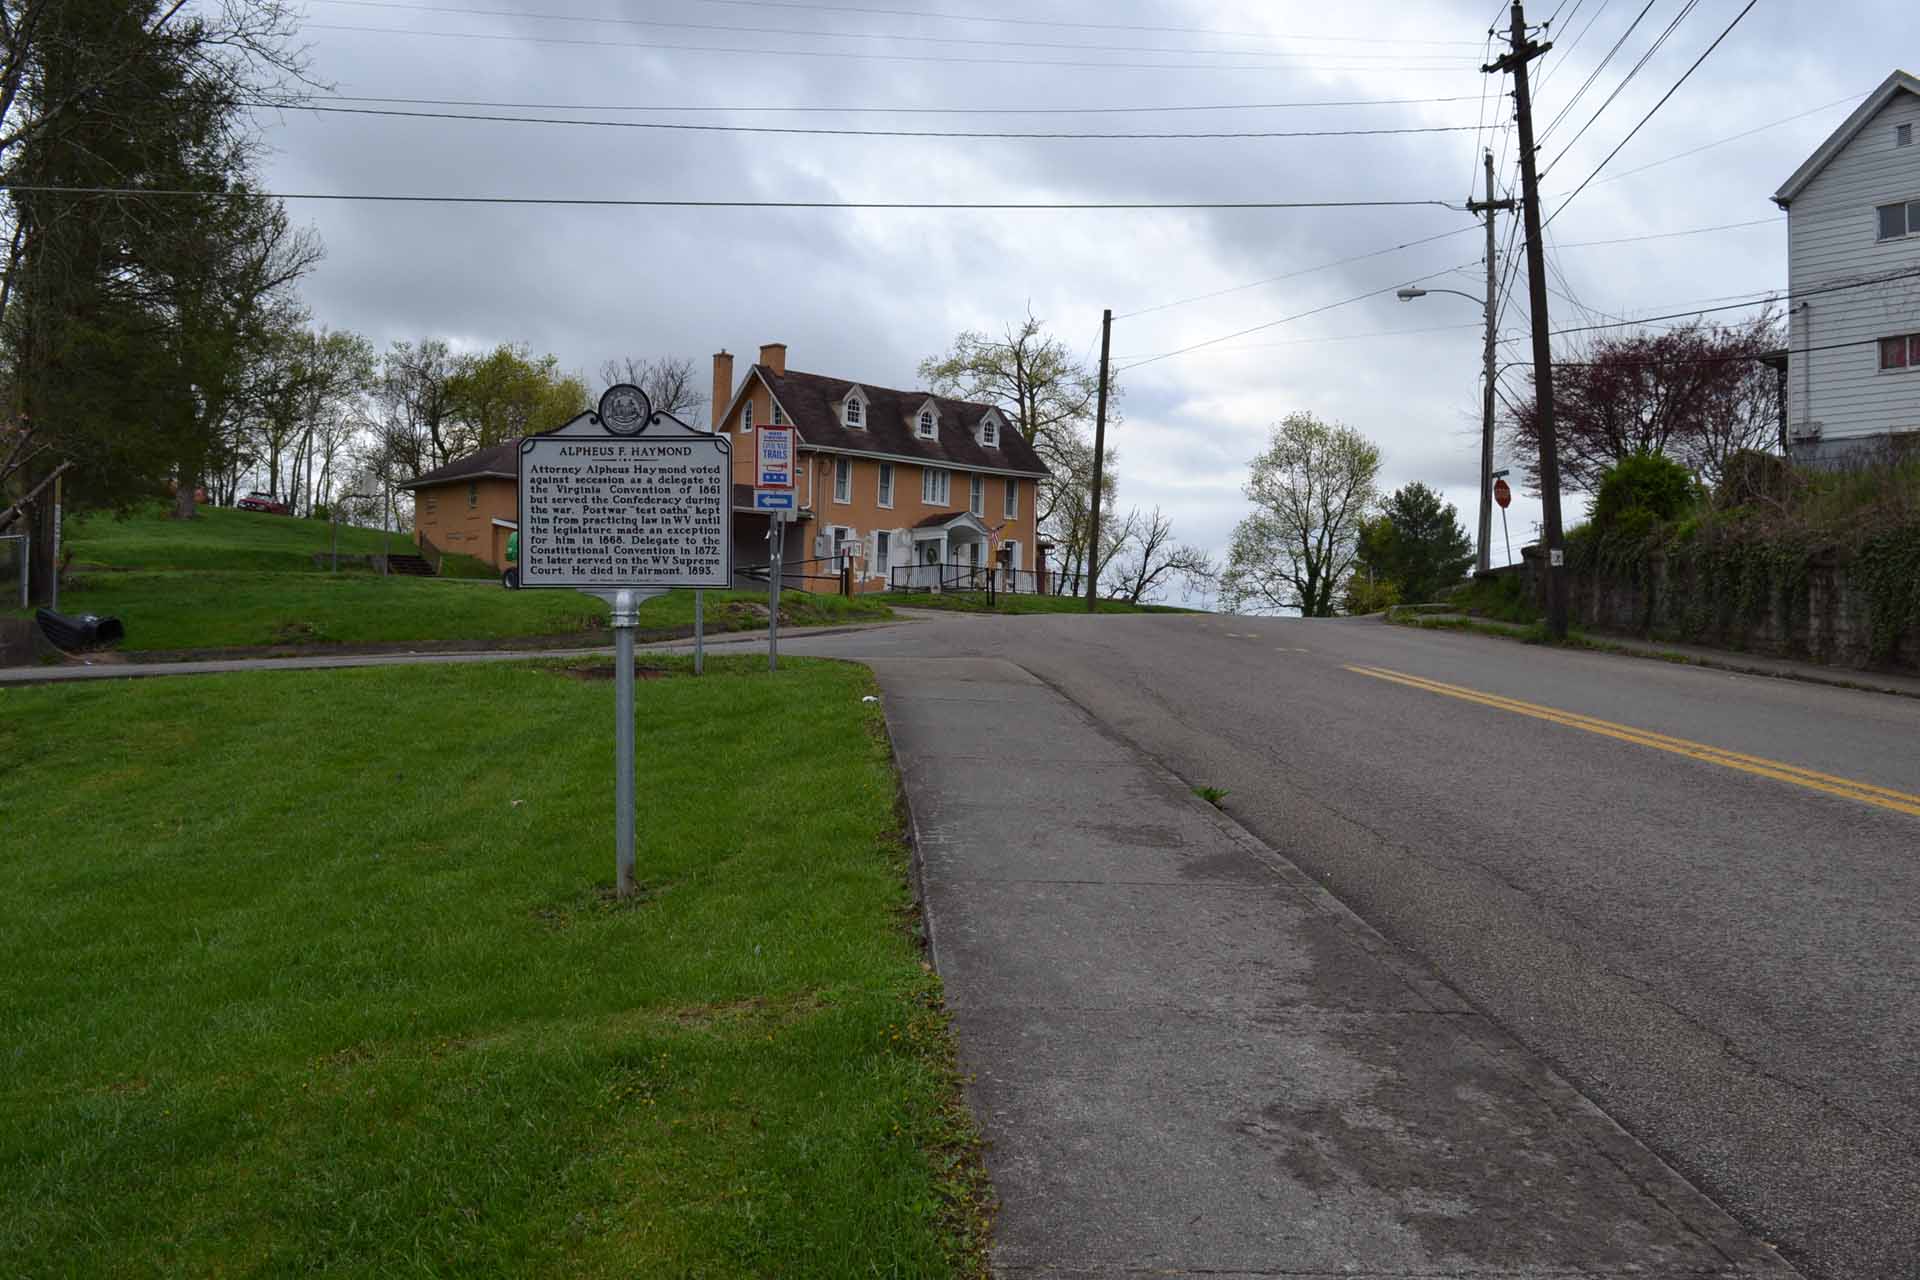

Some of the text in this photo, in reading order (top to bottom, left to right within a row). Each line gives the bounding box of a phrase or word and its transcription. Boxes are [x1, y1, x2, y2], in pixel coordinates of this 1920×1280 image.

[560, 446, 692, 456] ALPHEUS F. HAYMOND
[530, 464, 720, 476] Attorney Alpheus Haymond voted
[530, 475, 569, 486] against
[575, 475, 624, 484] secession
[658, 475, 705, 486] delegate
[708, 475, 720, 484] to
[530, 485, 720, 496] the Virginia Convention of 1861
[530, 495, 720, 506] but served the Confederacy during
[530, 505, 548, 515] the
[552, 507, 575, 515] war.
[582, 505, 628, 515] Postwar
[695, 505, 720, 517] kept
[530, 515, 720, 527] him from practicing law in WV until
[530, 526, 720, 536] the legislature made an exception
[530, 536, 548, 545] for
[555, 536, 576, 545] him
[582, 536, 593, 545] in
[631, 536, 680, 547] Delegate
[685, 536, 697, 545] to
[702, 536, 720, 545] the
[530, 546, 609, 555] Constitutional
[613, 546, 676, 555] Convention
[680, 546, 691, 555] in
[530, 556, 720, 567] he later served on the WV Supreme
[571, 566, 586, 575] He
[590, 566, 613, 575] died
[617, 566, 627, 575] in
